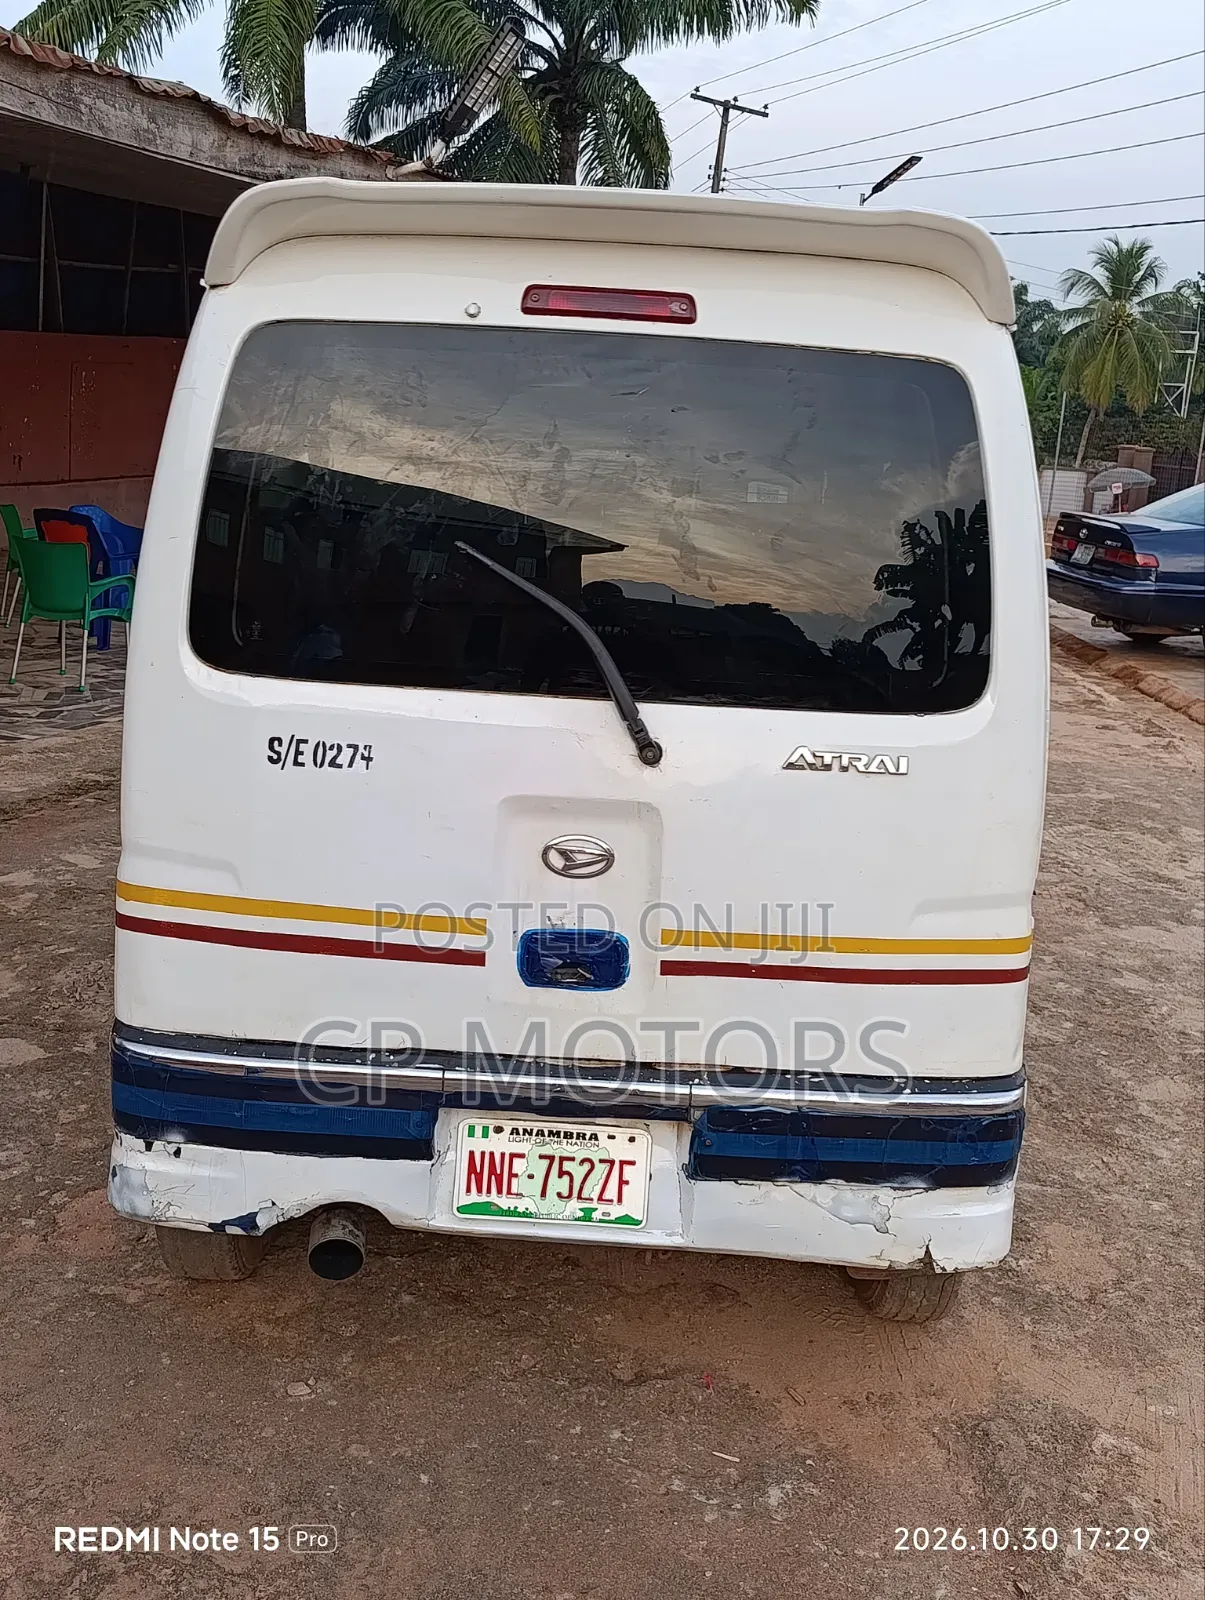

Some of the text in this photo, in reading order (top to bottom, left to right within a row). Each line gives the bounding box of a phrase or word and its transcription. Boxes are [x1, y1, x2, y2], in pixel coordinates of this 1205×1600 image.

[267, 734, 309, 770] S/E
[782, 745, 909, 775] ATRAI
[508, 1136, 532, 1144] LIGHT
[566, 1140, 600, 1148] NATION
[509, 1127, 599, 1141] ANAMBRA
